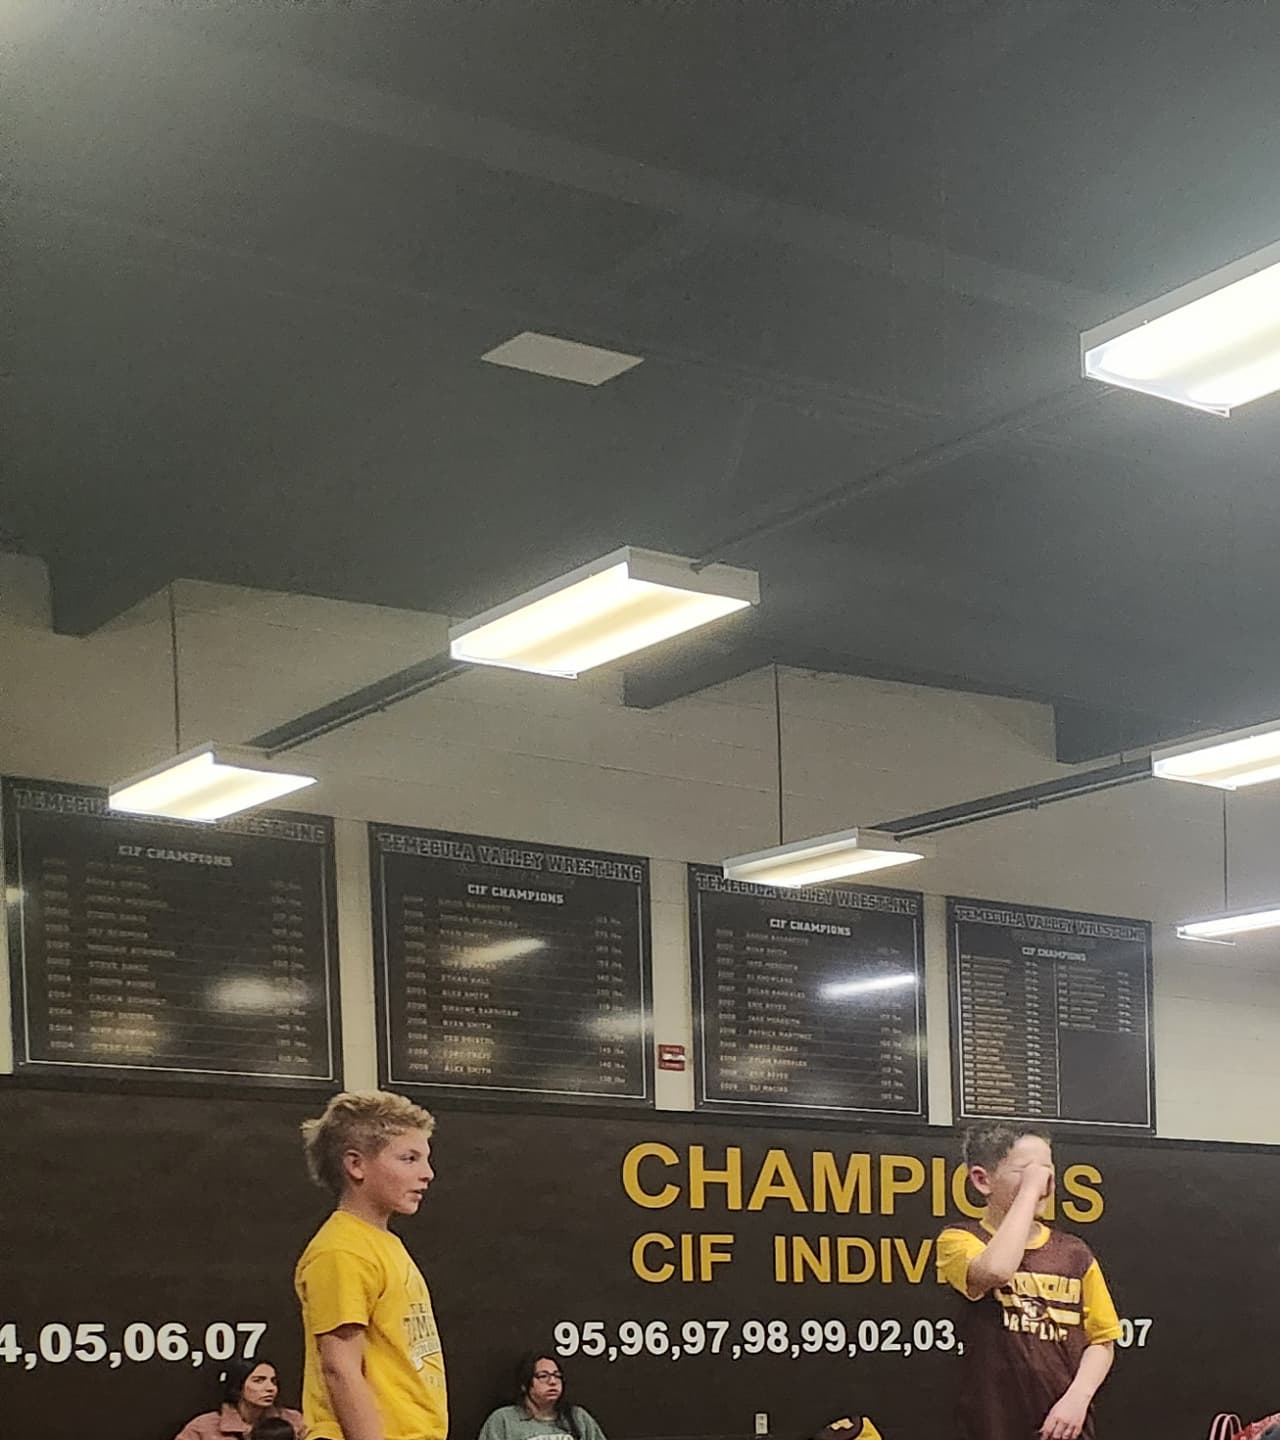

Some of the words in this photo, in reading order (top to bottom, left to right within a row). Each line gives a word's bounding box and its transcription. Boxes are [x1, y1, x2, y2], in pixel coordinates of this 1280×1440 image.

[479, 846, 544, 871] VALLEY
[549, 854, 643, 882] WRESTLING
[467, 883, 487, 896] CIF
[491, 886, 565, 904] CHAMPIONS
[769, 918, 788, 930] CIF
[789, 920, 851, 937] CHAMPIONS
[621, 1141, 1105, 1223] CHAMPIOS
[631, 1231, 735, 1284] CIF
